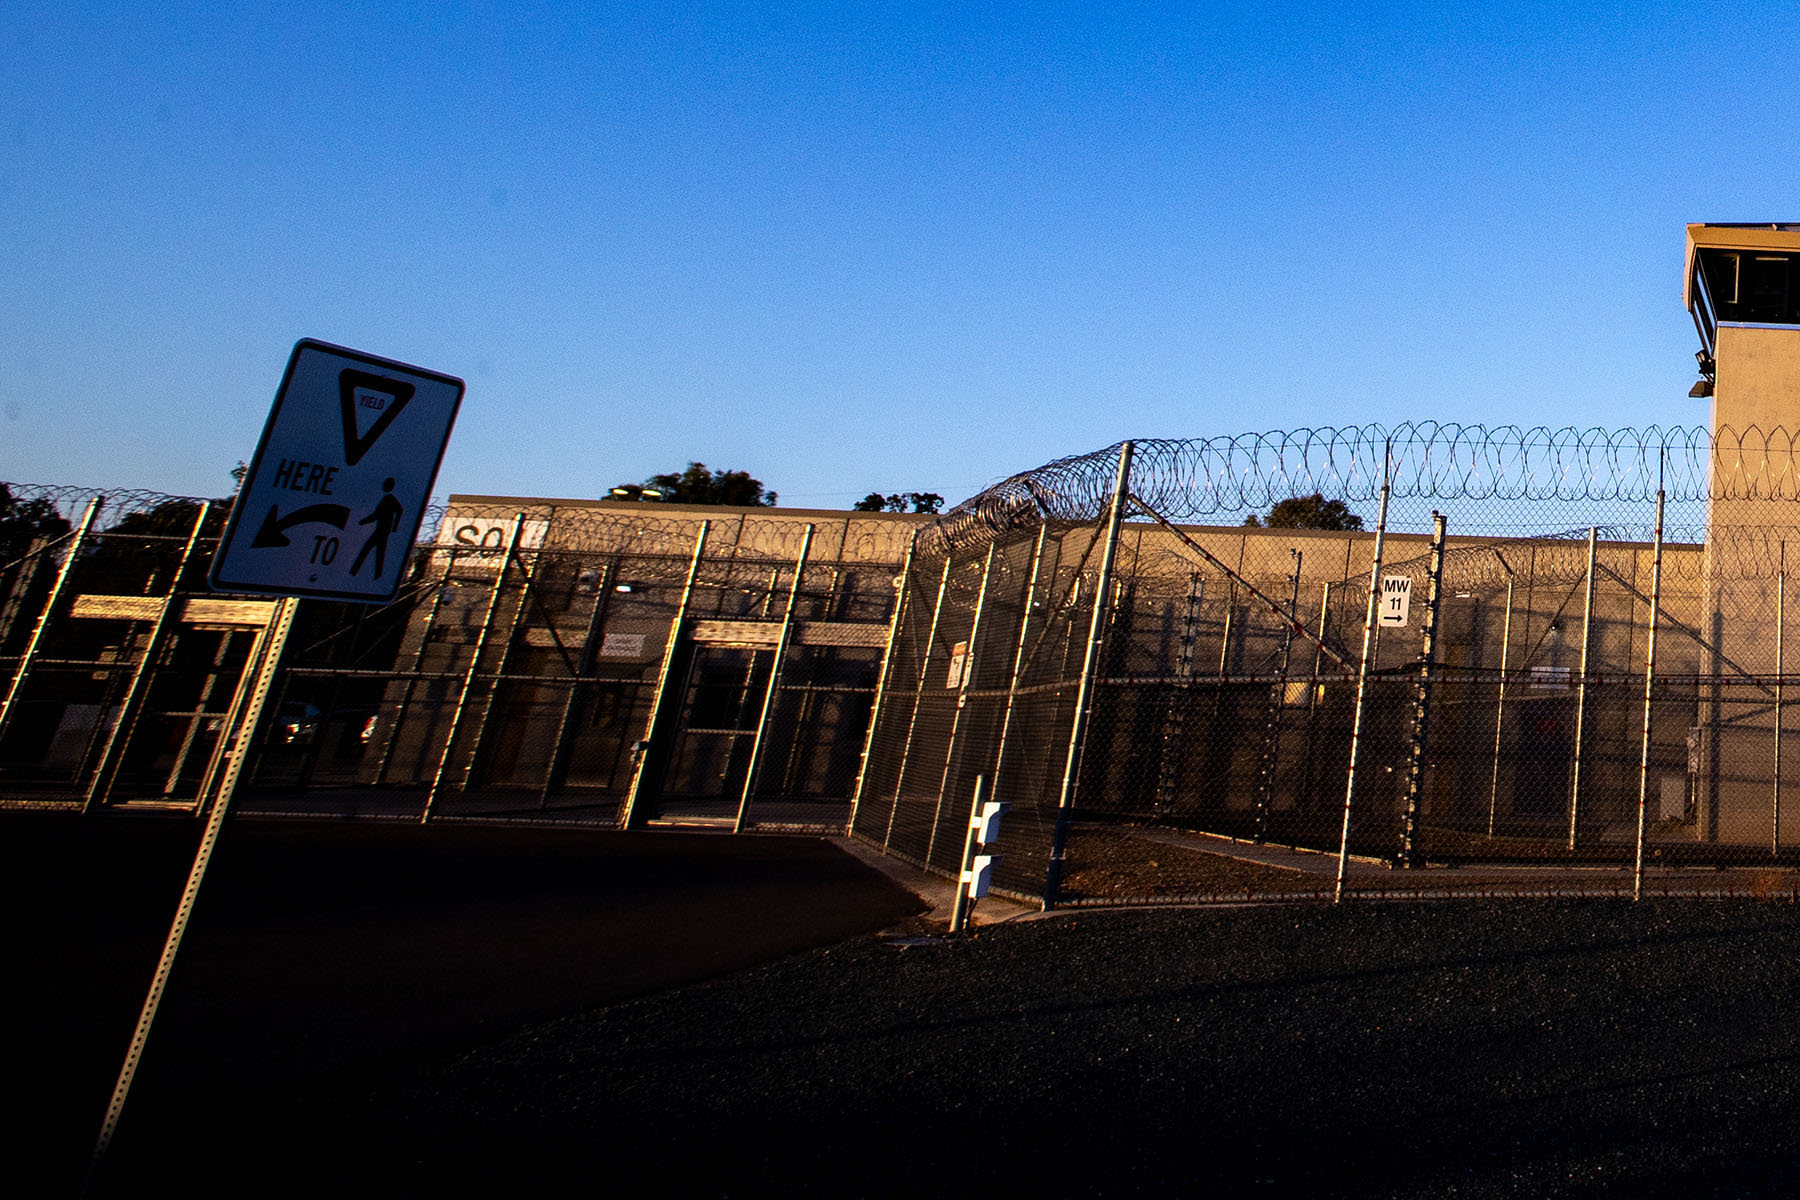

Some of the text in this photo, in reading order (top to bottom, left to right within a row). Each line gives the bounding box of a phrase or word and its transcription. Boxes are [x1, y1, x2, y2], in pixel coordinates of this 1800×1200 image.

[359, 394, 385, 410] YIELD
[273, 458, 340, 496] HERE
[310, 535, 339, 565] TO
[1384, 579, 1410, 593] MW
[1389, 597, 1402, 611] 11
